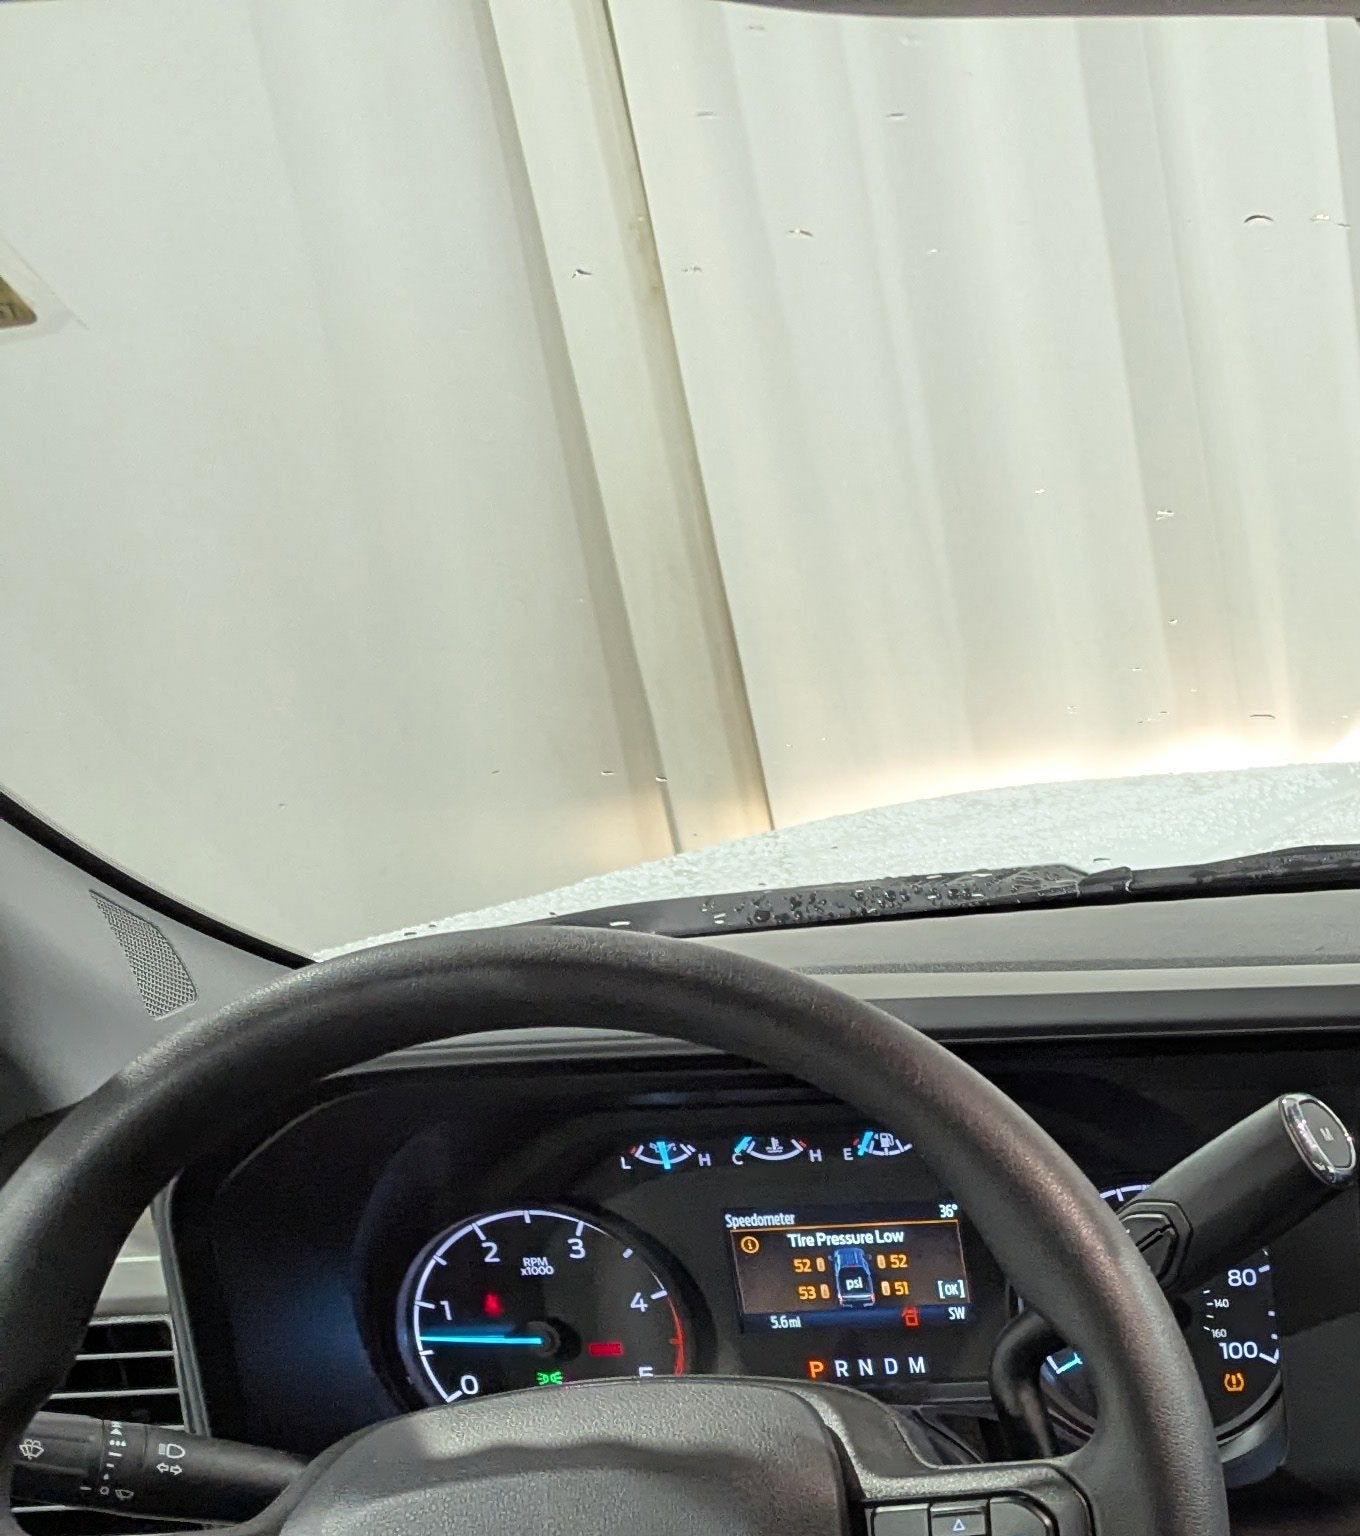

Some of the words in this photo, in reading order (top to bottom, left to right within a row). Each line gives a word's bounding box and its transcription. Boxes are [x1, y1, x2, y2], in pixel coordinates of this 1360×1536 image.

[698, 1153, 712, 1167] H
[731, 1153, 744, 1166] C
[809, 1149, 823, 1163] H
[842, 1148, 854, 1161] E
[621, 1156, 632, 1170] L
[938, 1203, 958, 1219] 36°
[724, 1212, 796, 1229] Speedometer
[786, 1233, 815, 1248] Tire
[816, 1231, 874, 1247] Pressure
[875, 1229, 905, 1244] Low
[481, 1241, 501, 1263] 2
[567, 1238, 586, 1260] 3
[522, 1256, 549, 1267] RPM
[793, 1257, 812, 1274] 52
[889, 1254, 909, 1269] 52
[845, 1276, 864, 1290] psi
[1227, 1268, 1257, 1287] 80
[798, 1286, 817, 1301] 53
[894, 1281, 910, 1296] 51
[439, 1300, 453, 1321] 1
[630, 1292, 649, 1313] 4
[1213, 1298, 1230, 1309] 140
[948, 1305, 966, 1321] SW
[1210, 1328, 1228, 1339] 160
[1218, 1341, 1259, 1360] 100
[809, 1360, 825, 1379] P
[833, 1359, 850, 1378] R
[857, 1358, 874, 1377] N
[883, 1357, 899, 1375] D
[907, 1355, 927, 1374] M
[460, 1374, 480, 1395] 0
